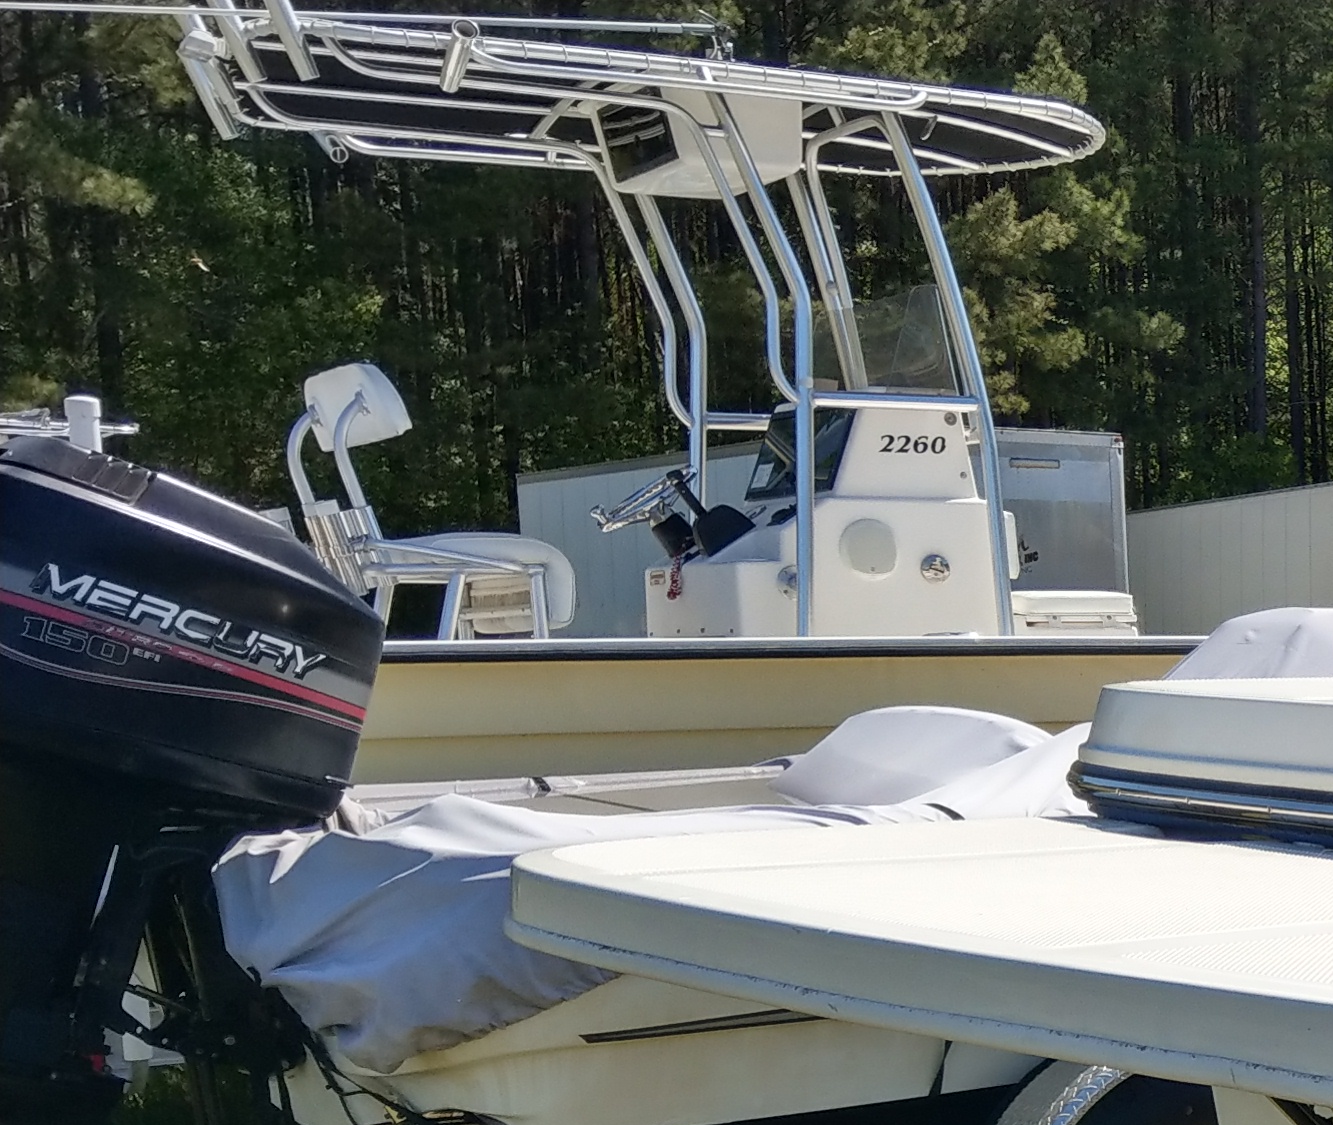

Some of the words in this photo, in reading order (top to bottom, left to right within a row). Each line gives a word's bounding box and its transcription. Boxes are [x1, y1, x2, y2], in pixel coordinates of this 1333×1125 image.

[878, 434, 946, 454] 2260
[20, 616, 130, 665] 150
[132, 647, 161, 663] EFI
[30, 562, 326, 679] MERCURY
